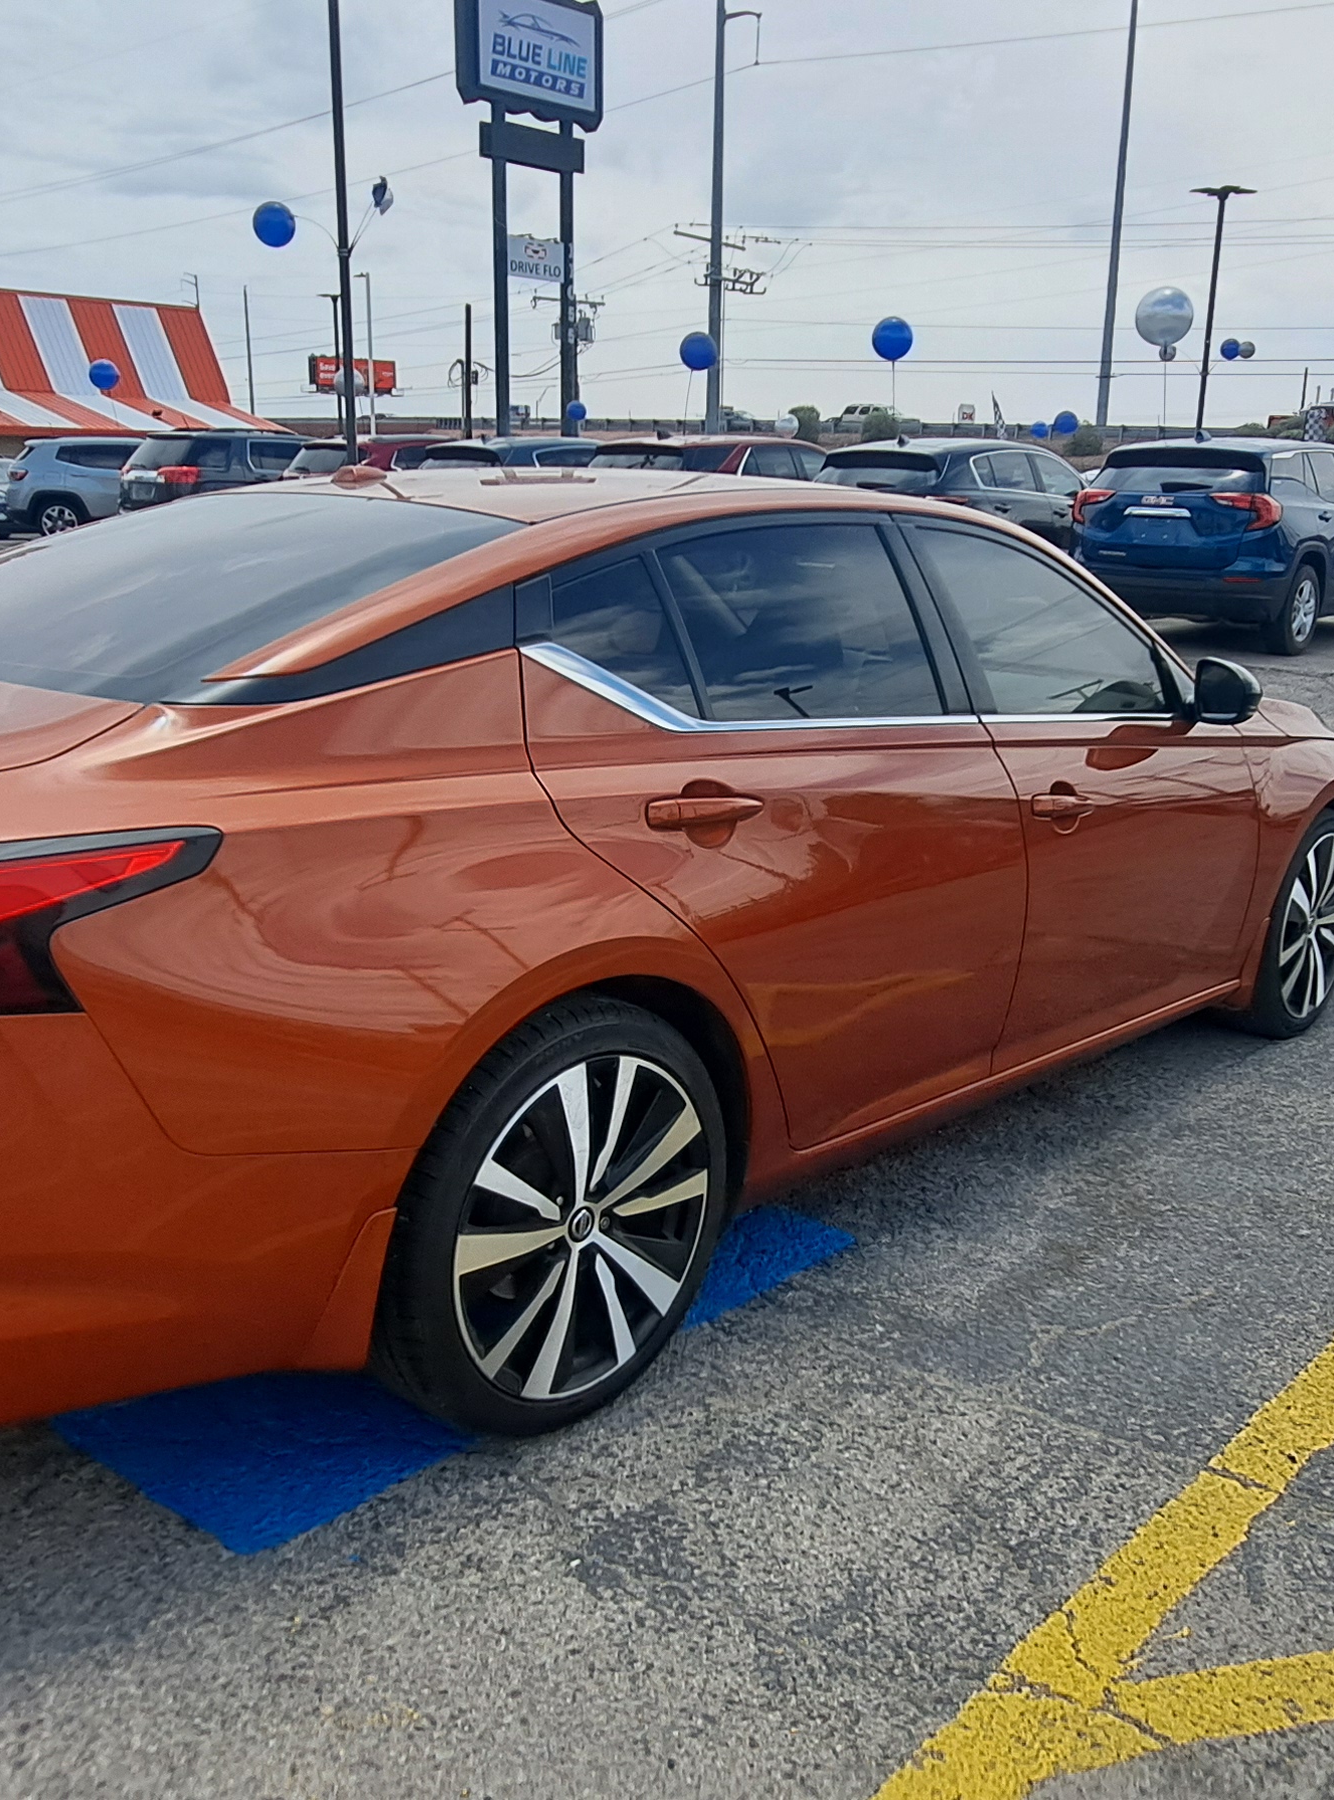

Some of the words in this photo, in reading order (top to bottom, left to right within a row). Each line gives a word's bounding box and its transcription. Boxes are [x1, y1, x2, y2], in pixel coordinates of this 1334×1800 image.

[492, 33, 543, 66] BLUE
[547, 47, 588, 79] LINE
[496, 62, 581, 96] MOTORS
[510, 259, 541, 275] DRIVE
[543, 265, 562, 278] FLO
[1140, 495, 1175, 506] GMC
